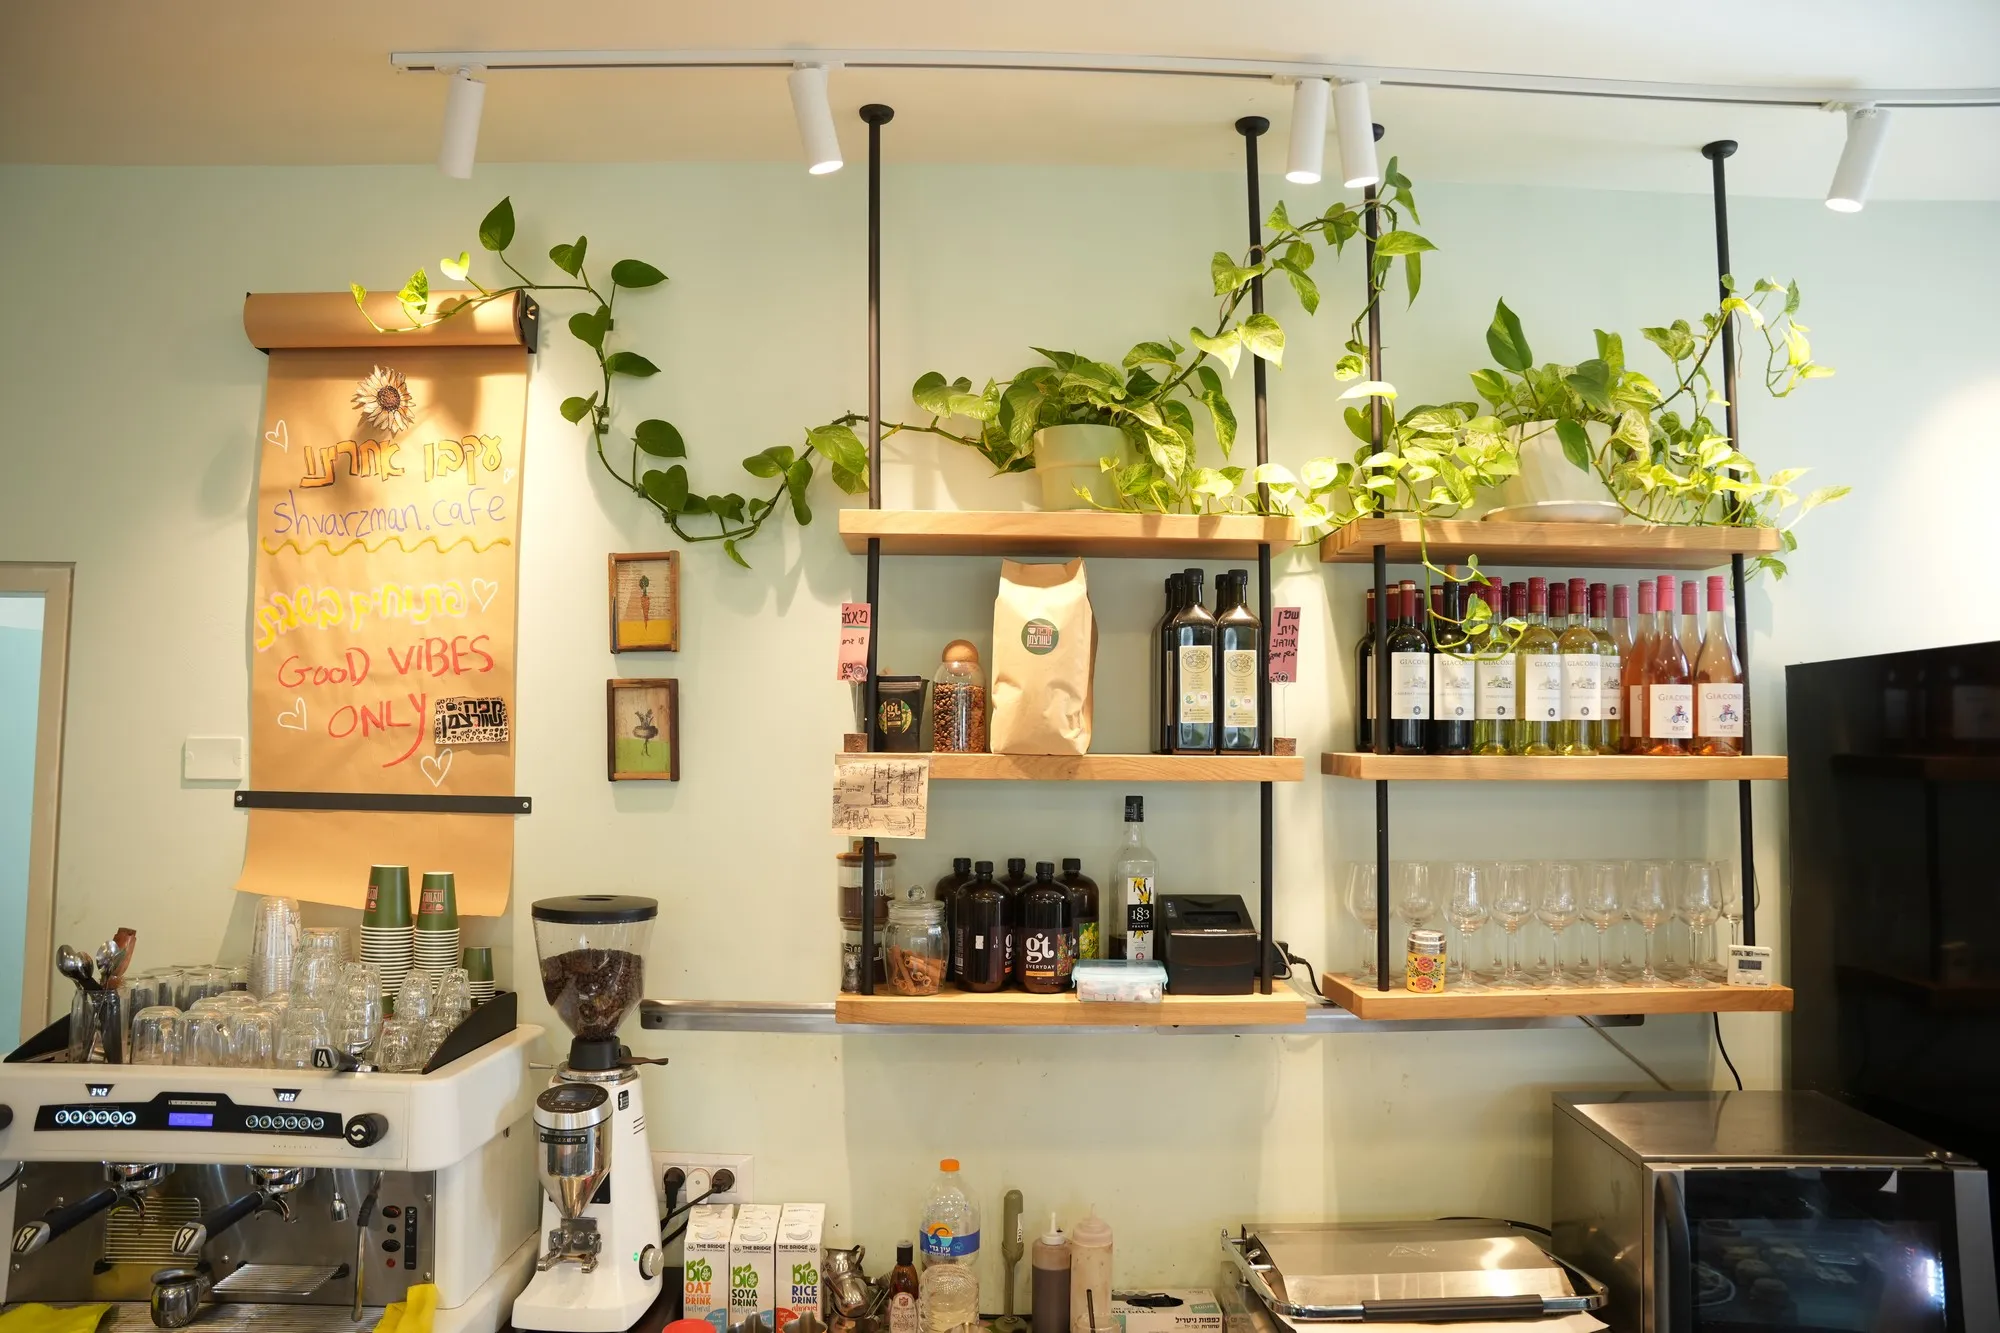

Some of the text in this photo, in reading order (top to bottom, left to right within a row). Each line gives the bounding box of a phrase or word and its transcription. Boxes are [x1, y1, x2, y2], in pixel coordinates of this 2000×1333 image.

[299, 438, 406, 489] אחרינו
[349, 578, 468, 633] פתוחים
[1026, 932, 1055, 964] gt
[685, 1281, 712, 1294] OAT
[791, 1285, 818, 1297] RICE
[731, 1288, 758, 1299] SOYA
[685, 1297, 712, 1305] DRINK
[731, 1298, 758, 1307] DRINK
[791, 1296, 818, 1305] DRINK
[1175, 1316, 1198, 1324] ניטריל
